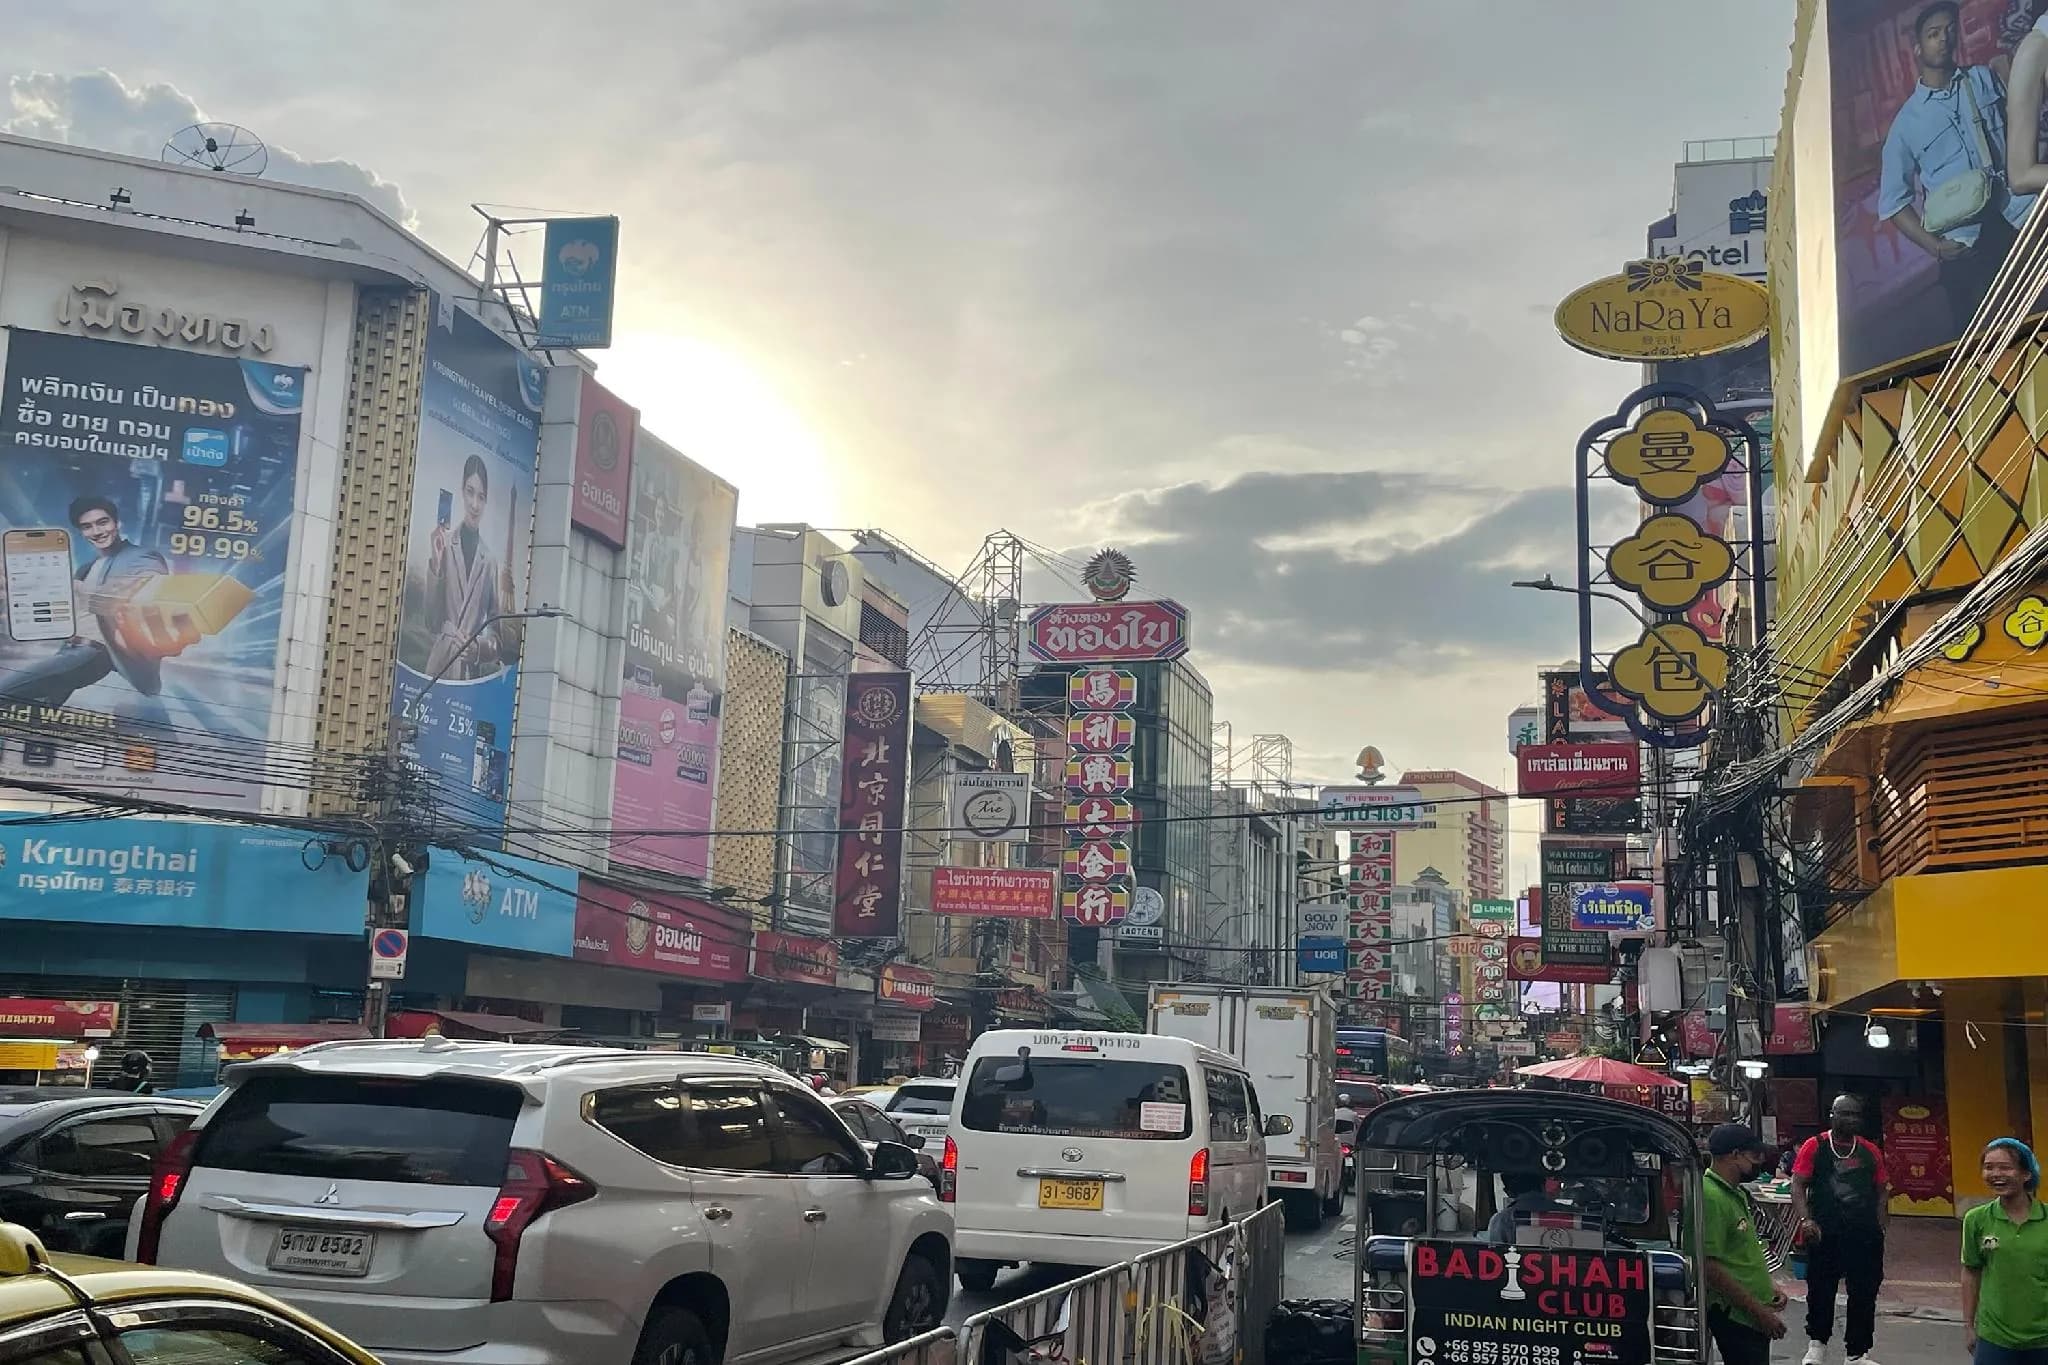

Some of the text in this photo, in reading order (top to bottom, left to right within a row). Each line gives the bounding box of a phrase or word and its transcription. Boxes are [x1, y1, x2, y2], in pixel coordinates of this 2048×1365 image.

[552, 279, 601, 297] กรุงไทย
[58, 279, 273, 353] เมืองทอง
[560, 305, 589, 318] ATM
[1590, 297, 1734, 334] NaRaYa
[21, 376, 236, 419] พลิกเงิน เป็นทอง
[18, 397, 171, 442] ซื้อ ขาย ถอน
[15, 429, 169, 461] ครบจบในแอปฯ
[183, 506, 258, 533] 96.5%
[170, 533, 265, 561] 99.99%
[1049, 608, 1111, 624] ห้างทอง
[630, 623, 673, 667] มีเงินทุน
[1046, 610, 1170, 653] ทองใบ
[853, 735, 890, 919] 北京同仁堂
[22, 838, 198, 875] Krungthai
[18, 871, 104, 895] กรุงไทย
[500, 888, 538, 920] ATM
[1304, 913, 1338, 922] GOLD
[655, 922, 702, 952] ออมสิน
[1121, 927, 1159, 936] LAOTENG
[1308, 922, 1334, 931] NOW
[1314, 951, 1338, 960] UOB
[1043, 1185, 1100, 1201] 31-9687
[320, 1236, 363, 1255] 8582
[1538, 1290, 1626, 1318] CLUB
[1444, 1313, 1622, 1337] INDIAN NIGHT CLUB
[1443, 1351, 1468, 1362] +66
[1472, 1352, 1498, 1365] 957
[1502, 1354, 1529, 1365] 970
[1444, 1340, 1560, 1357] +66 952 570 999
